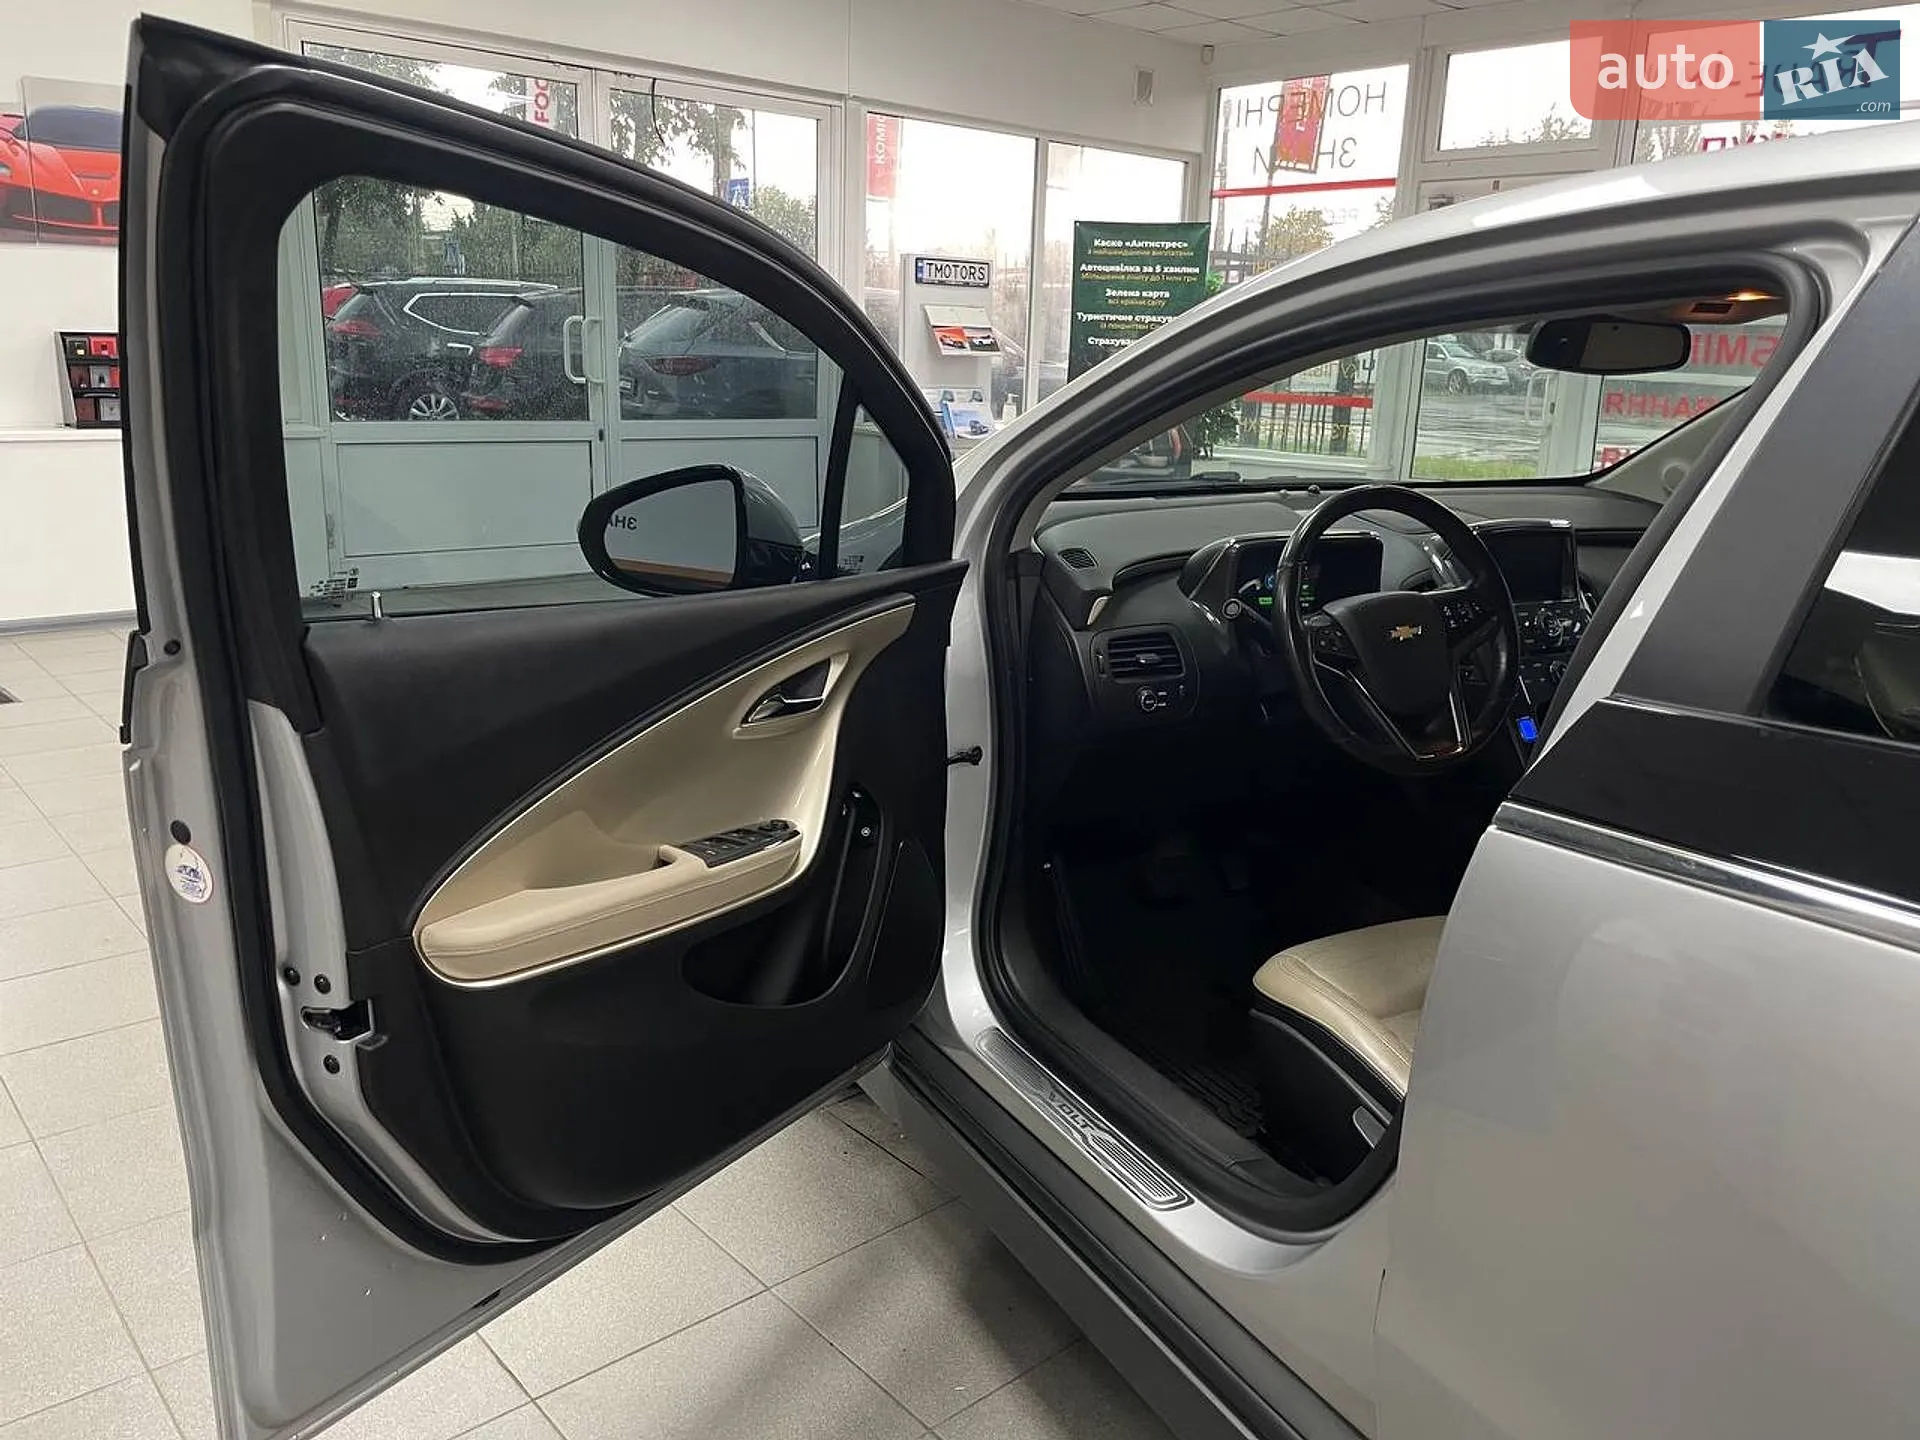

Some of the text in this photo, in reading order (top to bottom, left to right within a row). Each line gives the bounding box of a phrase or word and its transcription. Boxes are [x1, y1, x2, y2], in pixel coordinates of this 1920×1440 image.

[1094, 239, 1123, 247] Каско
[926, 262, 985, 281] TMOTORS
[1105, 288, 1170, 298] Зелена карта
